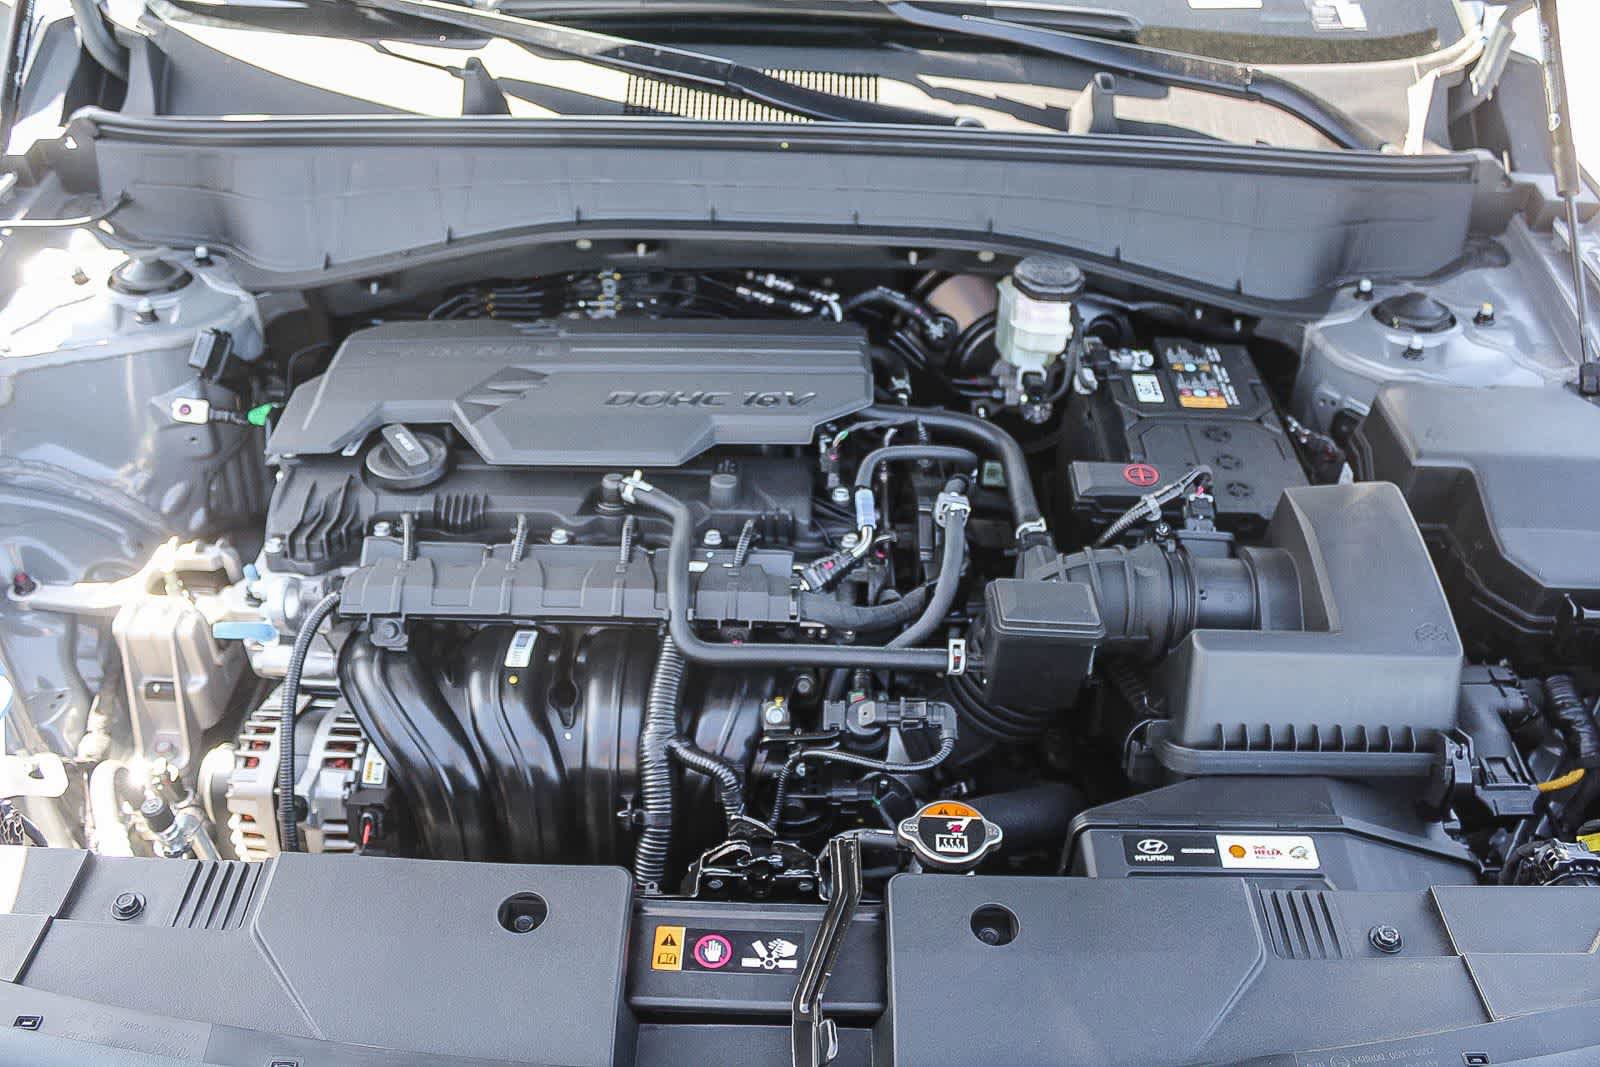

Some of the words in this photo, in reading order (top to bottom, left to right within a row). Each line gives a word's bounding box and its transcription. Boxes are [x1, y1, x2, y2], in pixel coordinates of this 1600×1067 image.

[604, 390, 733, 408] DOHC
[743, 390, 817, 408] 16V
[1134, 854, 1175, 862] HYUNDAI
